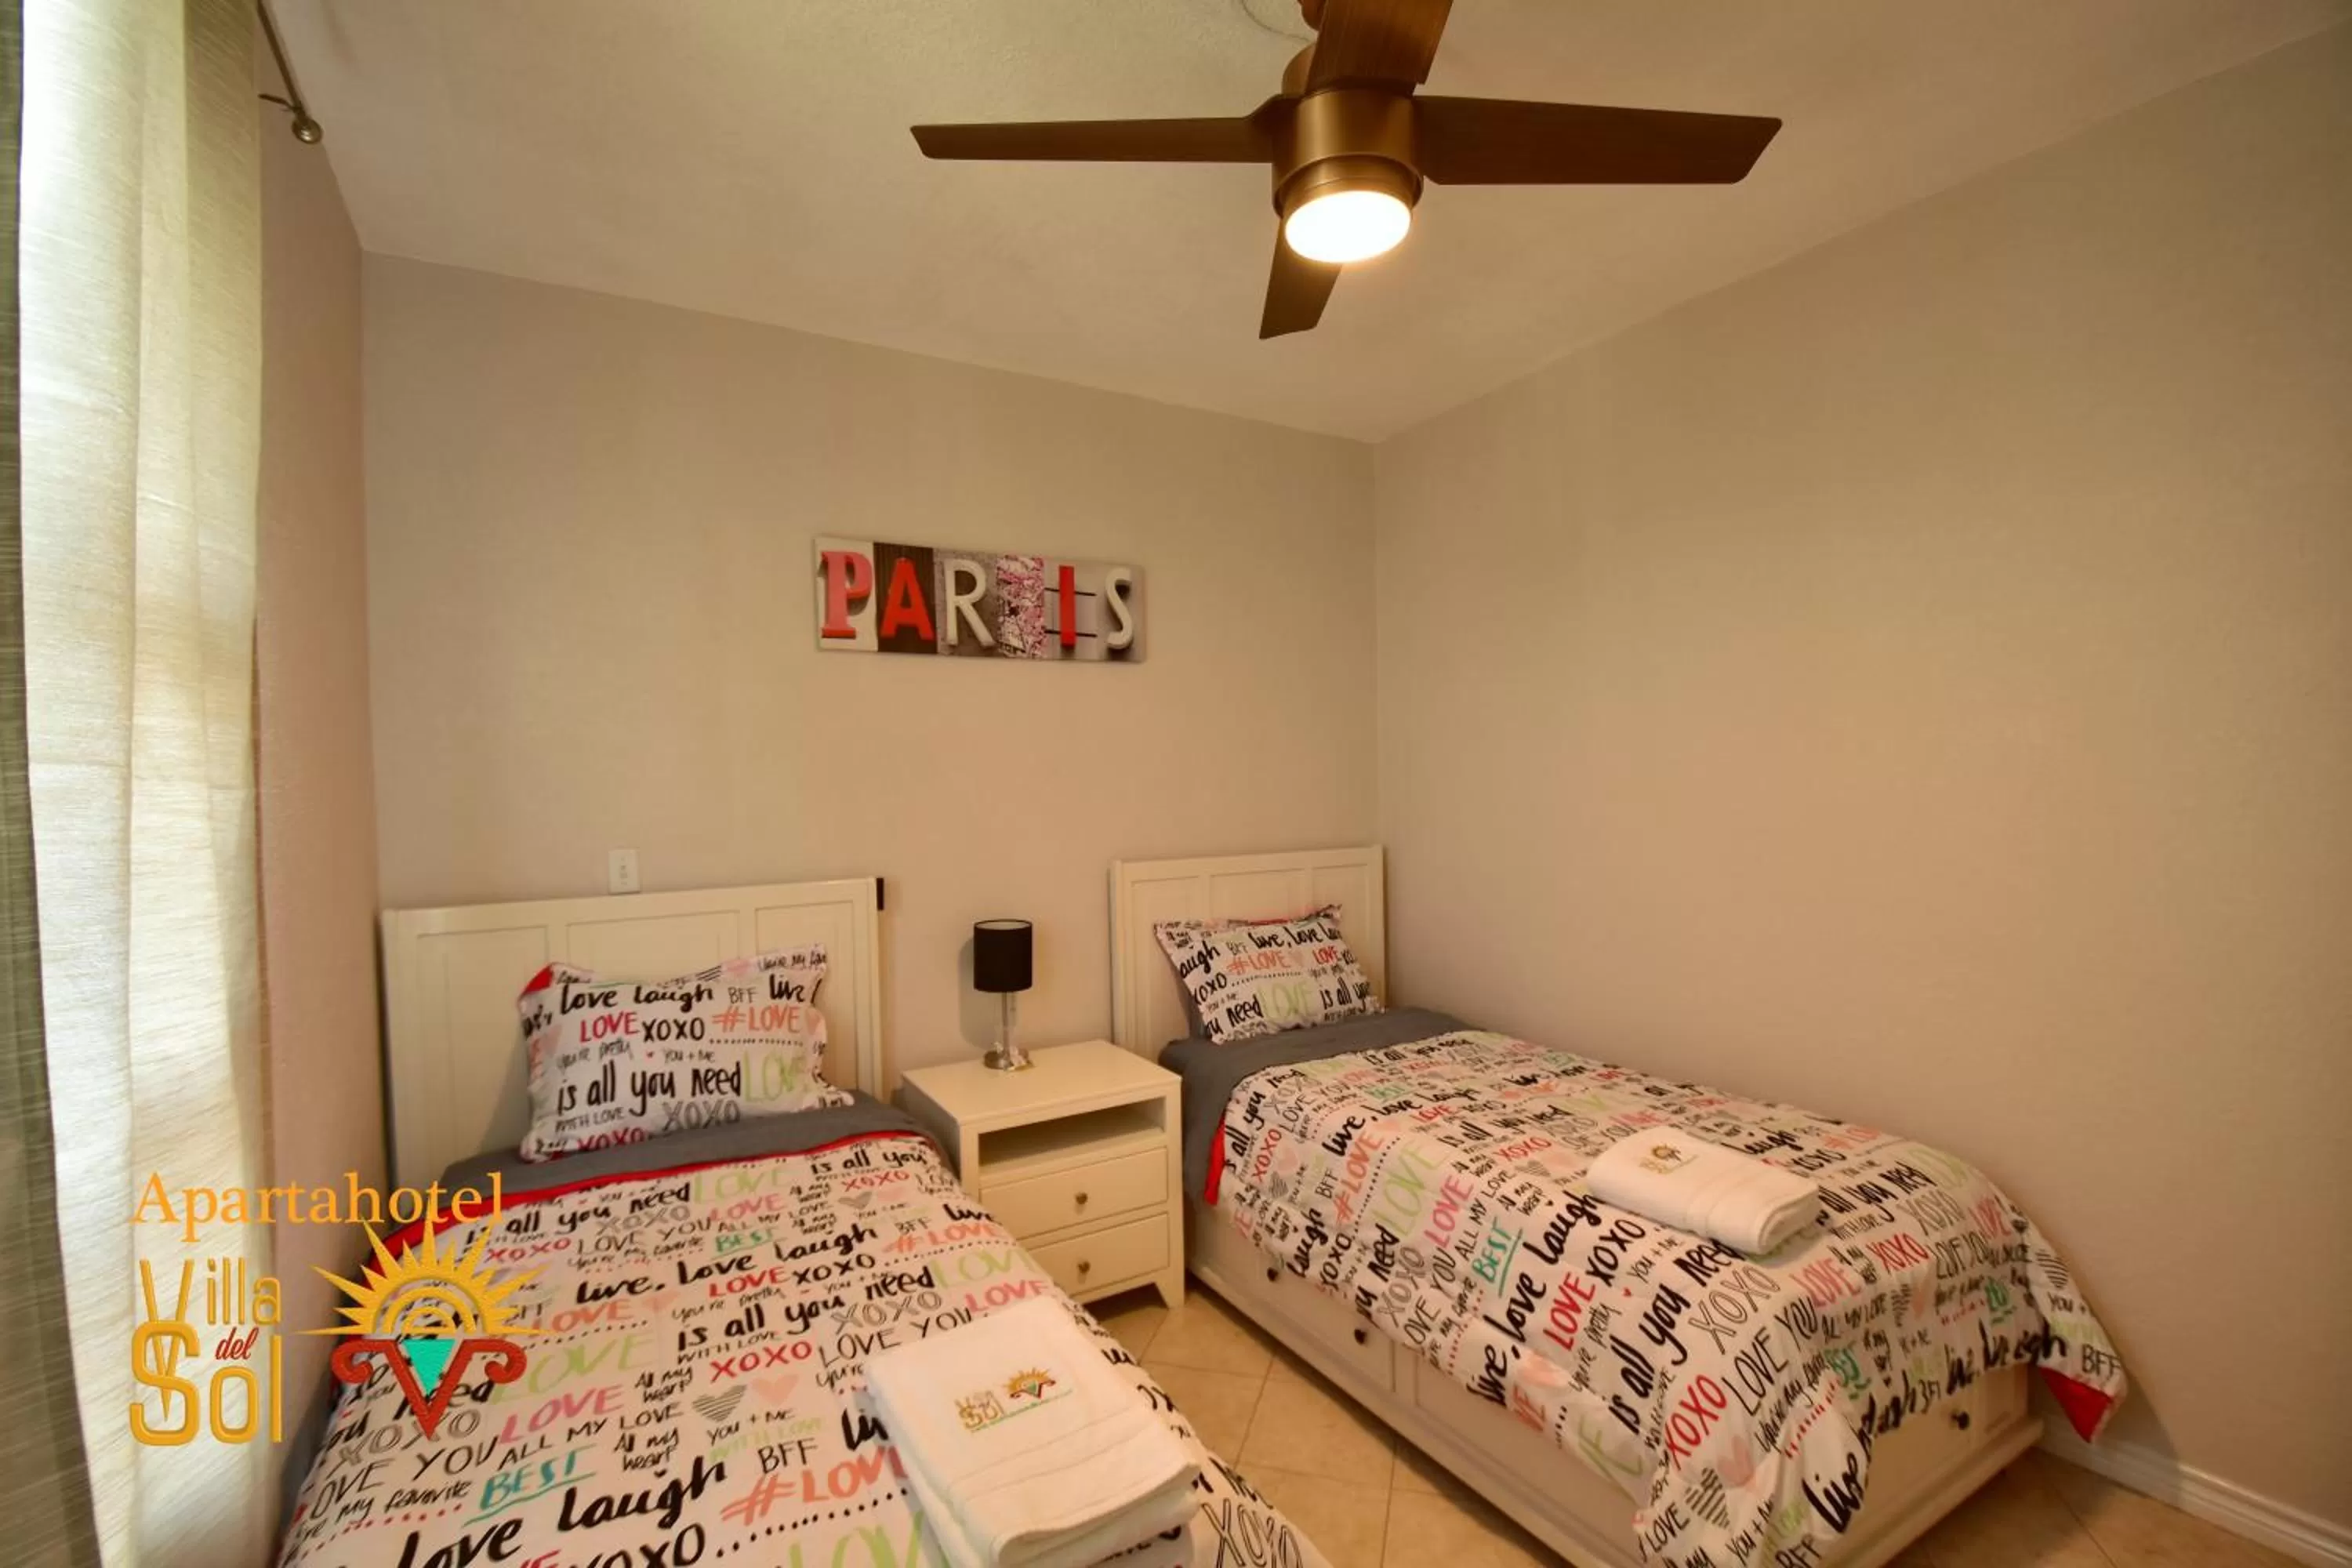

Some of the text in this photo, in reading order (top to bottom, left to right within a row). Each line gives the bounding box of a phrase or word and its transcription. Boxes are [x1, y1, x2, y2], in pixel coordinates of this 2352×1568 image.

[821, 550, 1134, 649] PARIS
[1179, 940, 1221, 979] augh
[559, 983, 619, 1015] love
[633, 982, 714, 1014] laugh
[728, 985, 758, 1004] BFF
[579, 1011, 641, 1044] LOVE
[642, 1016, 705, 1044] XOXO
[711, 1003, 801, 1034] #LOVE
[1225, 994, 1264, 1028] need
[557, 1078, 578, 1116] is
[587, 1058, 616, 1107] all
[629, 1069, 676, 1117] you
[691, 1060, 742, 1098] need
[840, 1169, 911, 1192] XOXO
[843, 1149, 870, 1170] all
[506, 1210, 541, 1235] all
[557, 1205, 612, 1236] you
[630, 1182, 691, 1213] need
[576, 1229, 646, 1255] LOVE
[657, 1215, 713, 1242] YOU
[710, 1192, 786, 1222] LOVE
[1422, 1174, 1475, 1248] LOVE
[488, 1236, 572, 1264] XOXO
[677, 1254, 757, 1286] love
[773, 1223, 877, 1262] laugh
[1286, 1207, 1330, 1279] laugh
[1429, 1246, 1457, 1294] YOU
[1483, 1271, 1547, 1343] love
[1523, 1188, 1607, 1266] laugh
[709, 1266, 793, 1298] LOVE
[793, 1254, 877, 1287] XOXO
[1542, 1218, 1646, 1352] LOVE XOXO
[1789, 1257, 1864, 1309] LOVE
[677, 1323, 710, 1350] is
[723, 1302, 766, 1338] all
[785, 1294, 846, 1334] you
[864, 1265, 935, 1301] need
[817, 1327, 903, 1370] LOVE
[909, 1305, 972, 1339] YOU
[829, 1290, 944, 1334] XOXO
[1607, 1237, 1748, 1436] is all you need
[1688, 1264, 1782, 1356] XOXO
[1773, 1295, 1819, 1352] YOU
[710, 1340, 813, 1383] XOXO
[1721, 1325, 1790, 1417] LOVE
[309, 1383, 625, 1521] OVE YOU LOVE
[498, 1400, 685, 1472] ALL MY LOVE
[1664, 1373, 1728, 1472] XOXO
[479, 1443, 598, 1510] BEST
[757, 1437, 818, 1474] BFF
[396, 1517, 526, 1568] love
[555, 1454, 728, 1533] laugh
[1647, 1501, 1691, 1554] LOVE
